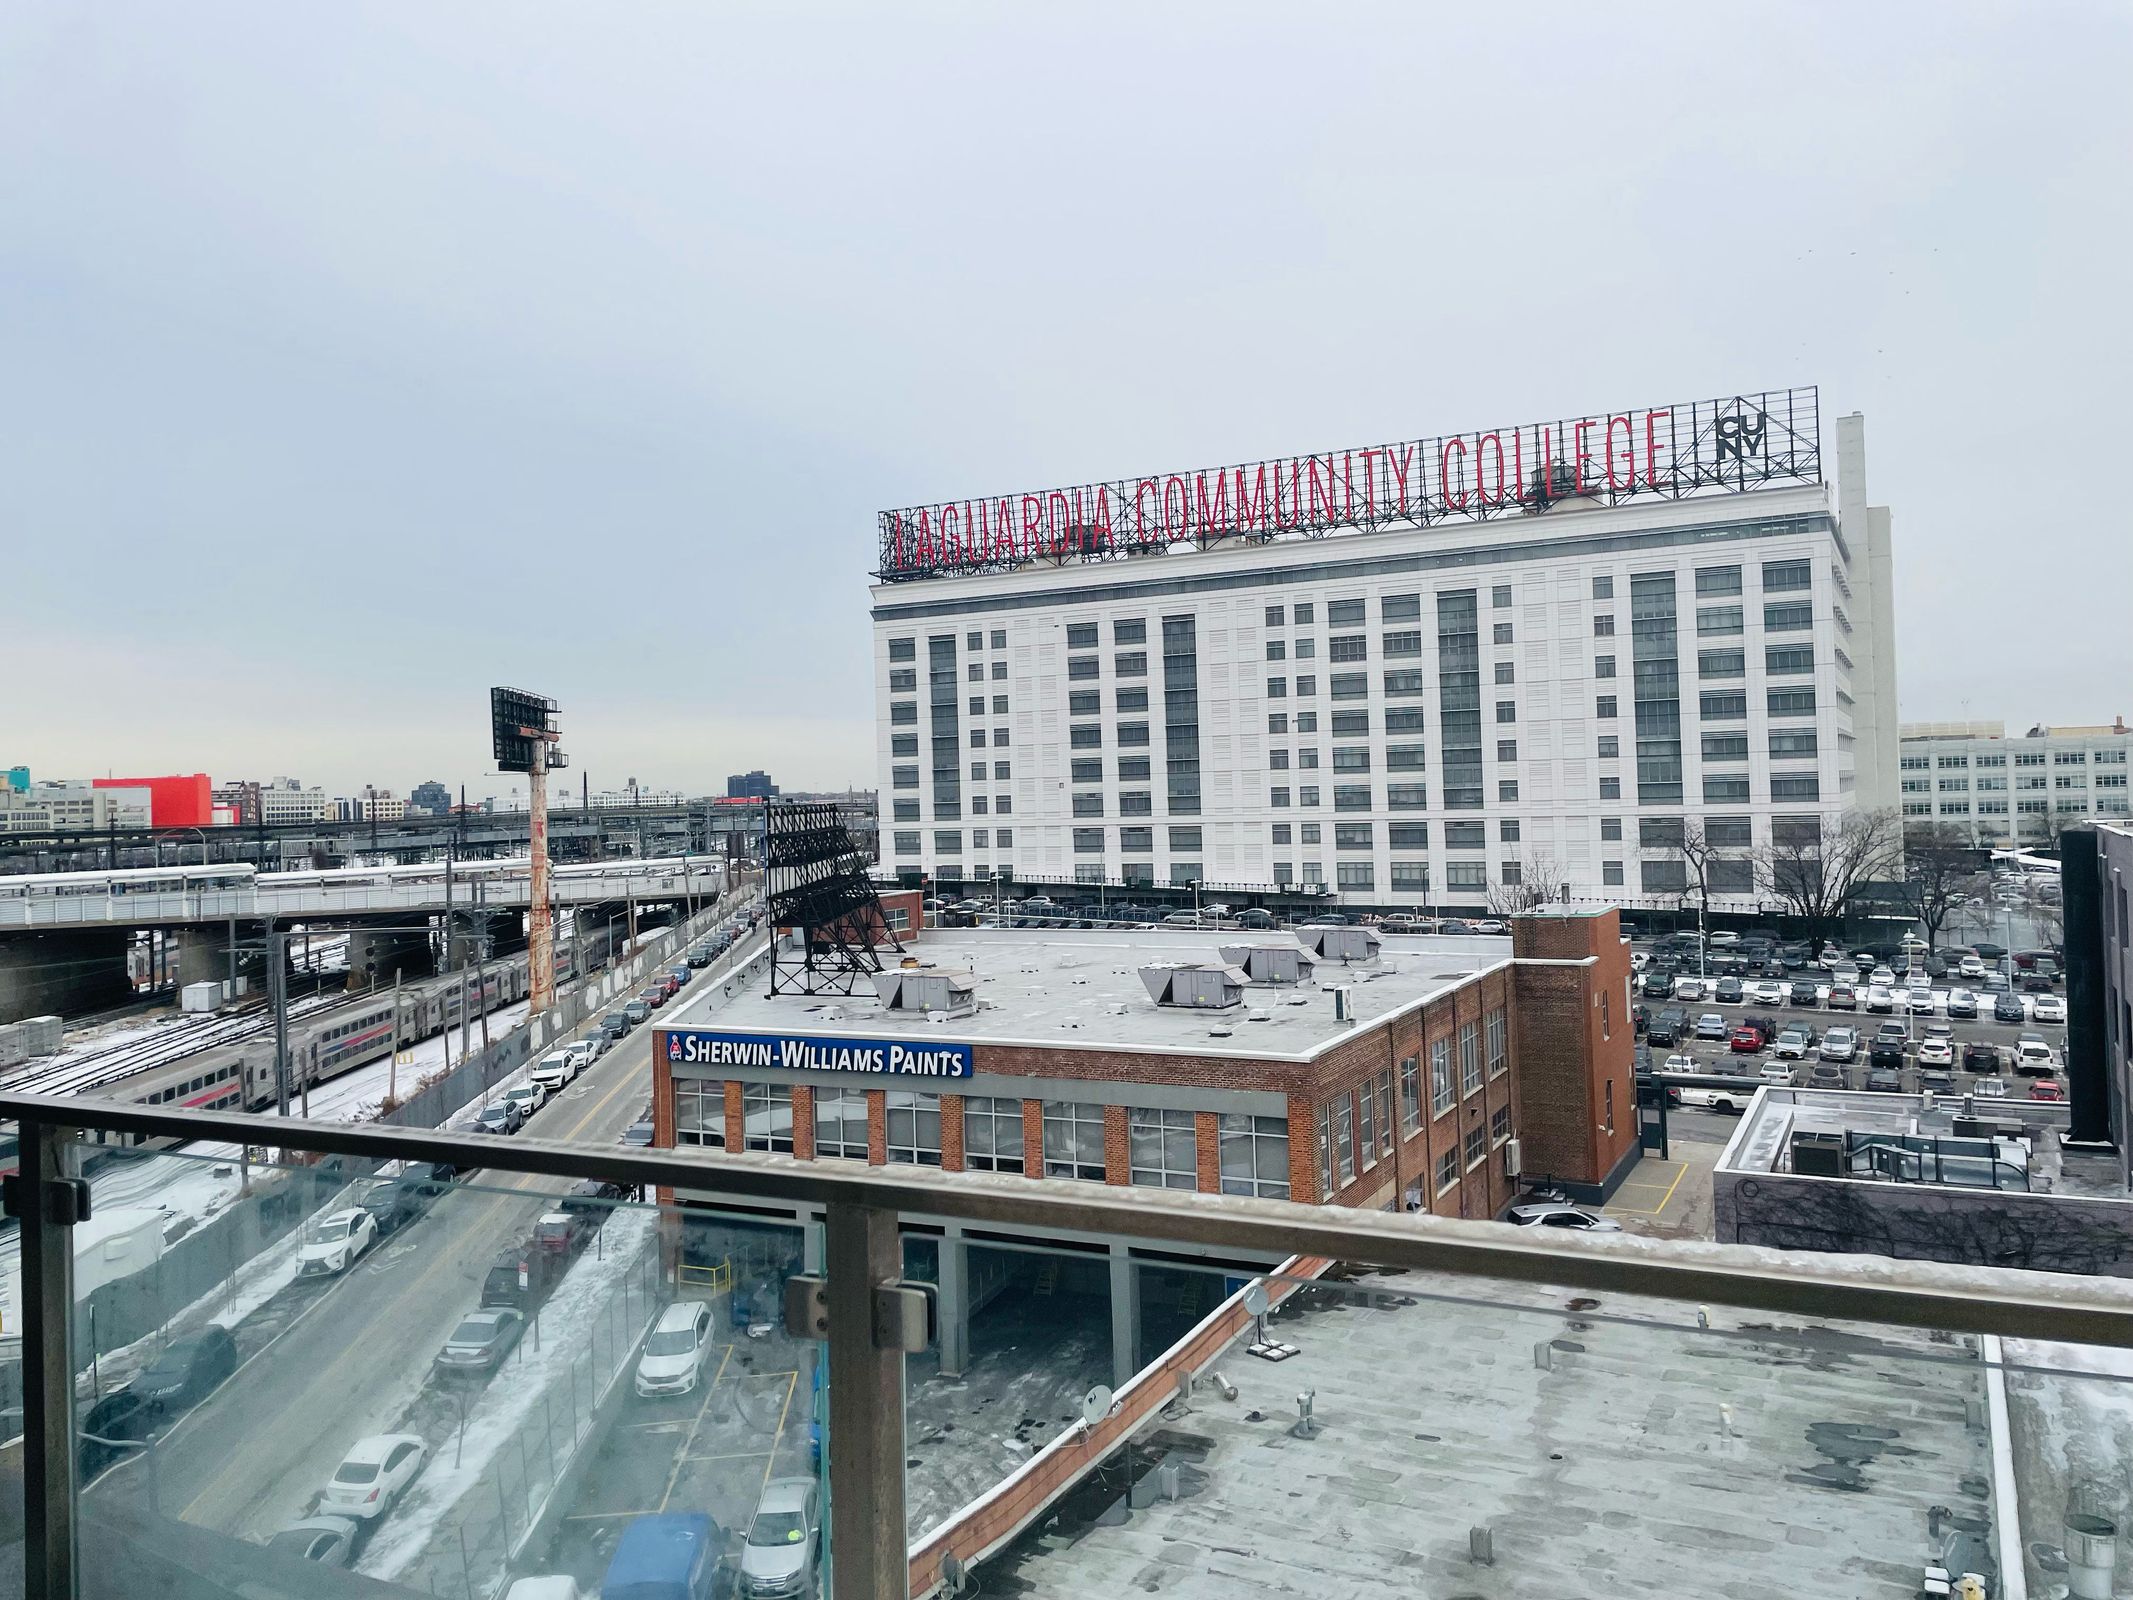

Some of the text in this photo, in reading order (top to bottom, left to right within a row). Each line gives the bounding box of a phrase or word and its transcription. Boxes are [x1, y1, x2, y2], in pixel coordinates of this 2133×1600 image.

[895, 411, 1671, 571] LAGUARDIA COMMUNITY COLLEGE
[685, 1035, 962, 1077] SHERWIN-WILLIAMS PAINTS
